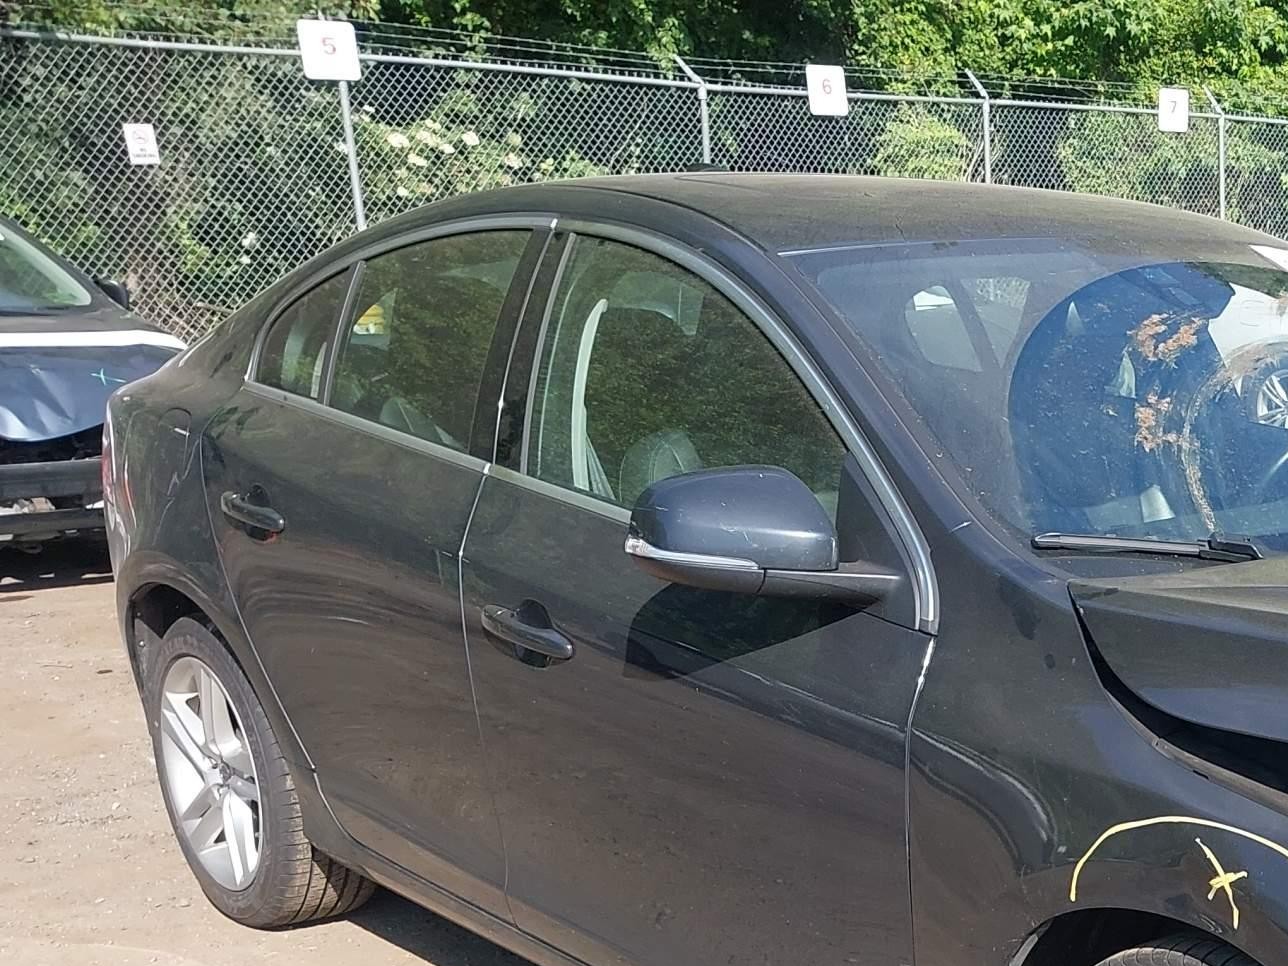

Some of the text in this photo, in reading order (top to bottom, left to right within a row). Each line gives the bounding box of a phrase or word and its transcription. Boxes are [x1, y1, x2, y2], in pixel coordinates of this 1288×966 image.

[321, 37, 337, 55] 5
[822, 78, 832, 95] 6
[1168, 100, 1177, 113] 7
